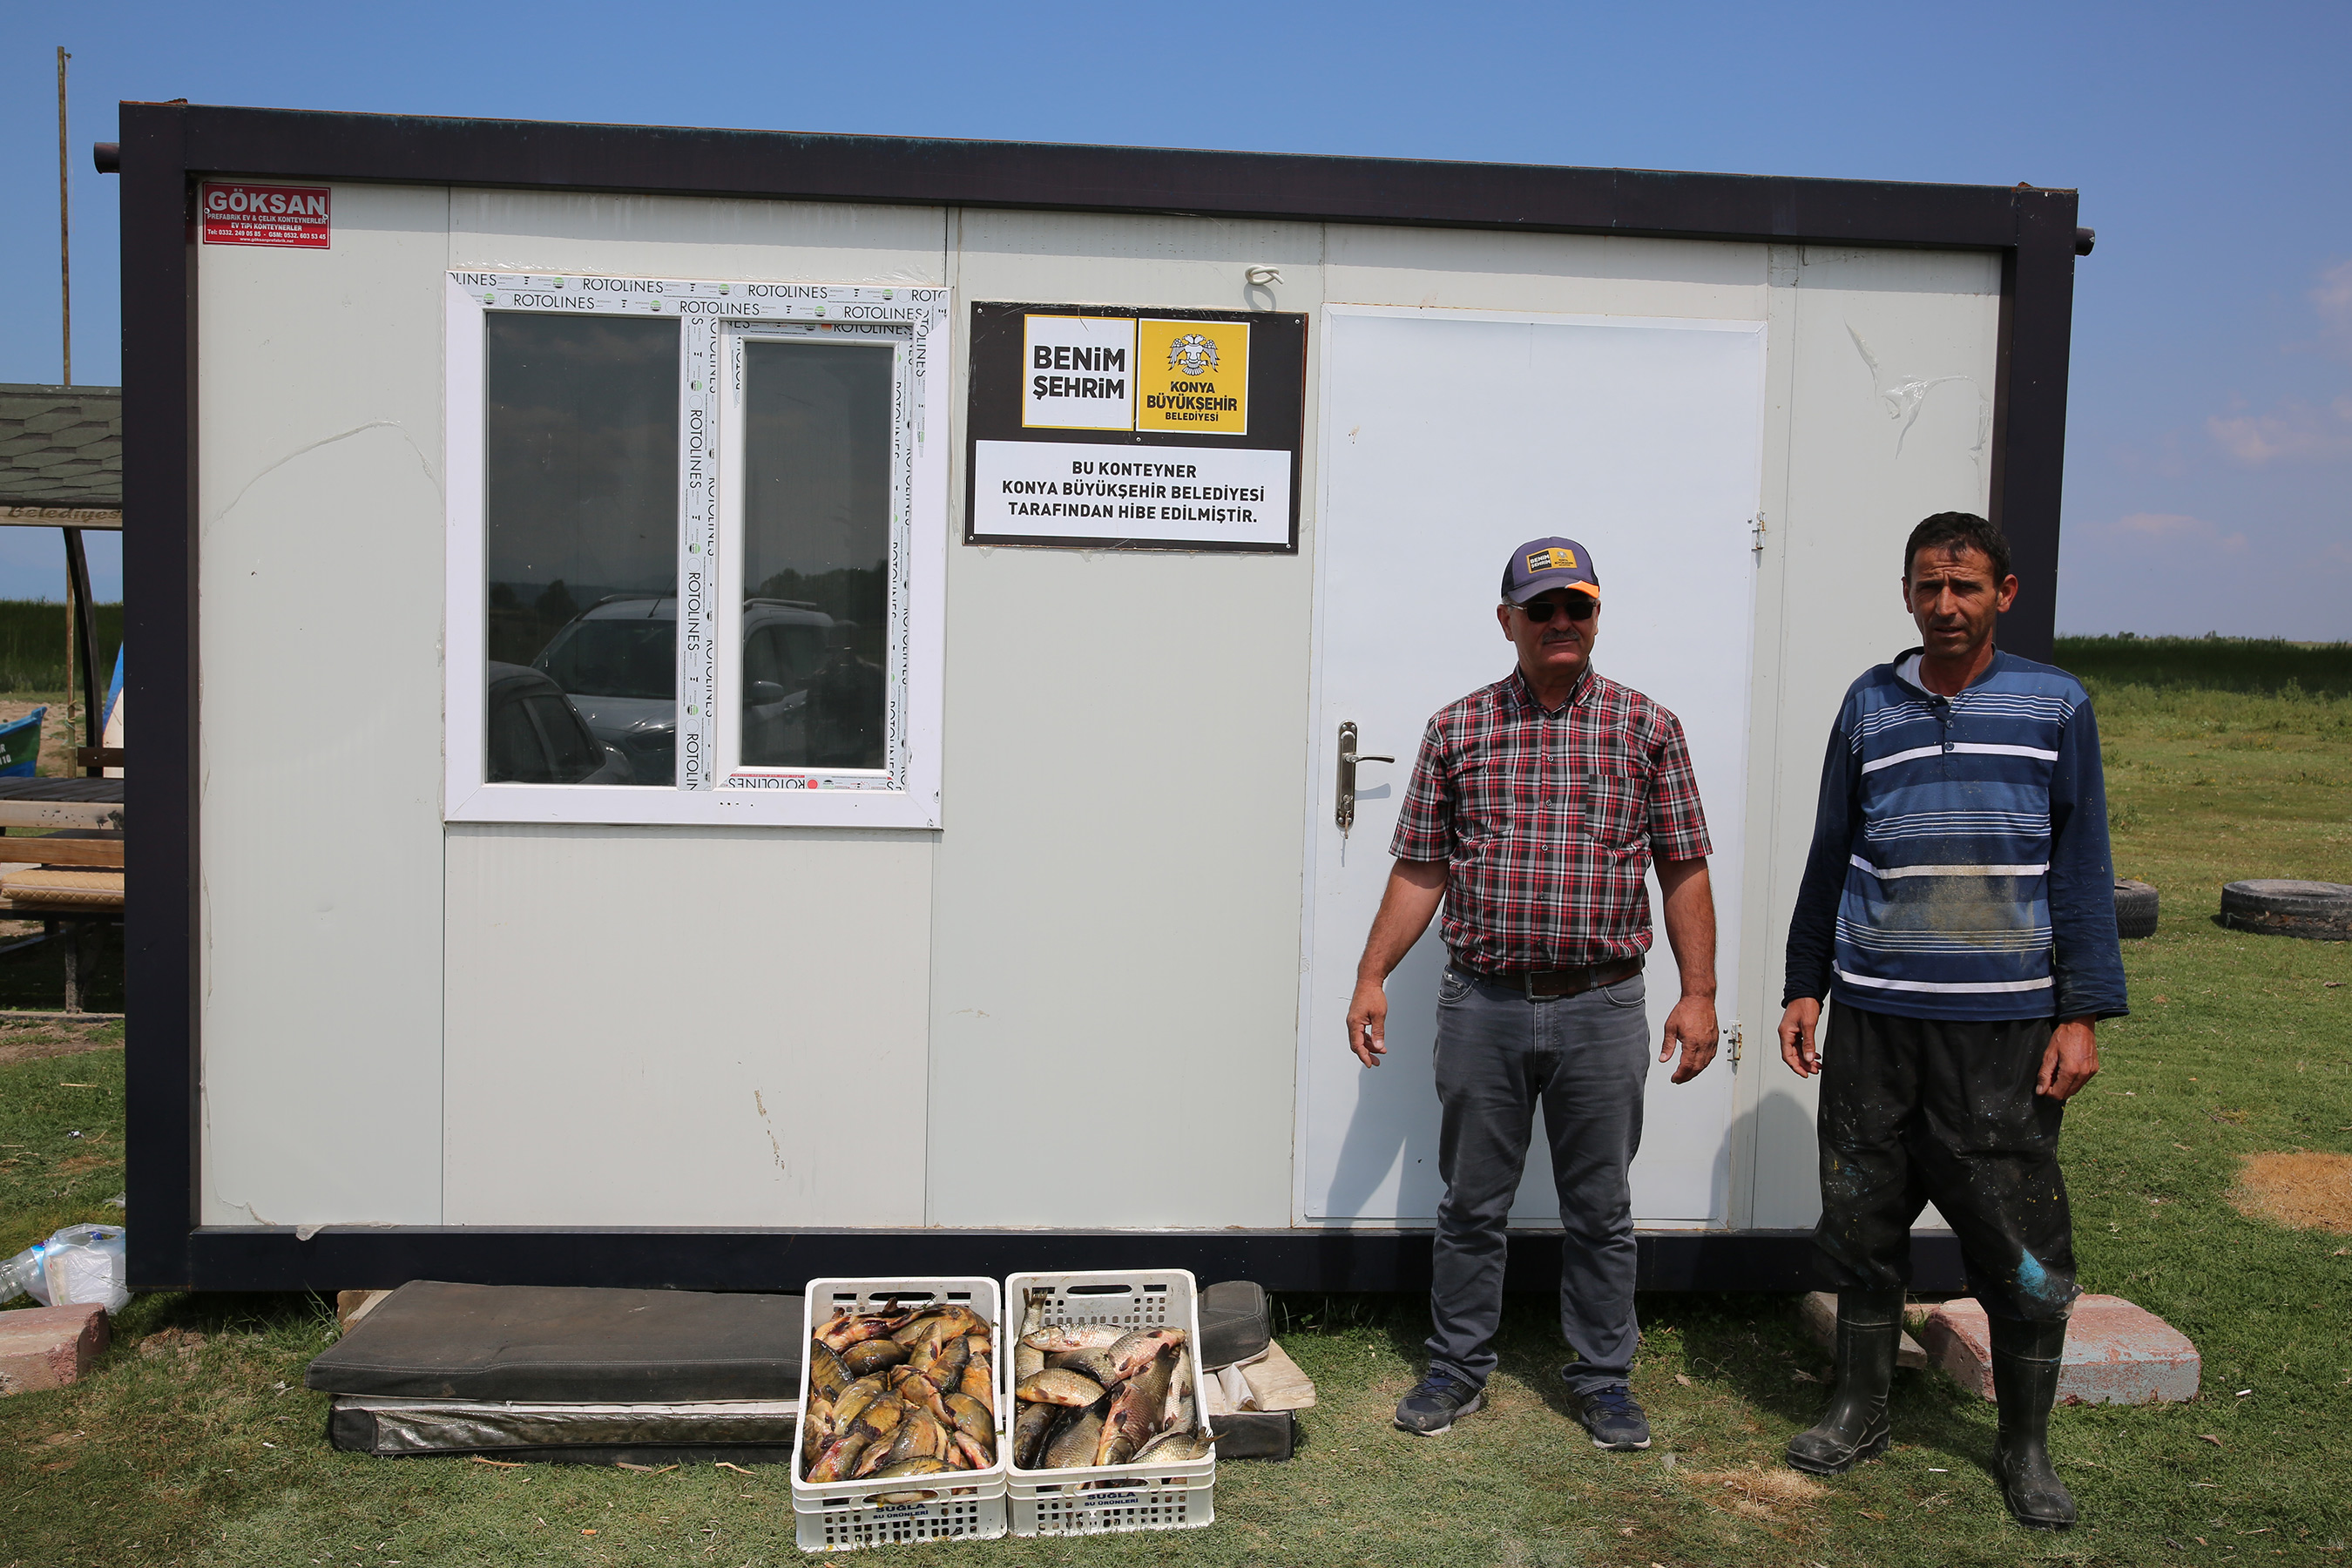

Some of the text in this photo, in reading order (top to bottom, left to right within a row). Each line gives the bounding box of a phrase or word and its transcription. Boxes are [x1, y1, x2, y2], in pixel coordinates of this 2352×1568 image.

[208, 188, 325, 215] GÖKSAN
[253, 223, 302, 232] KONTEYNERLER
[583, 278, 664, 294] ROTOLINES
[748, 284, 828, 299] ROTOLINES
[514, 294, 595, 309] ROTOLINES
[679, 301, 760, 315] ROTOLINES
[1170, 381, 1215, 394] KONYA
[1146, 393, 1238, 412] BÜYÜKŞEHİR
[1165, 411, 1219, 422] BELEDİYESİ
[689, 409, 703, 489] ROTOLINES
[1072, 461, 1197, 478] BU KONTEYNER
[1002, 478, 1265, 502] KONYA BÜYÜKŞEHİR BELEDİYESİ
[1008, 502, 1258, 524] TARAFINDAN HİBE EDİLMİŞTİR.
[686, 571, 701, 652] ROTOLINES
